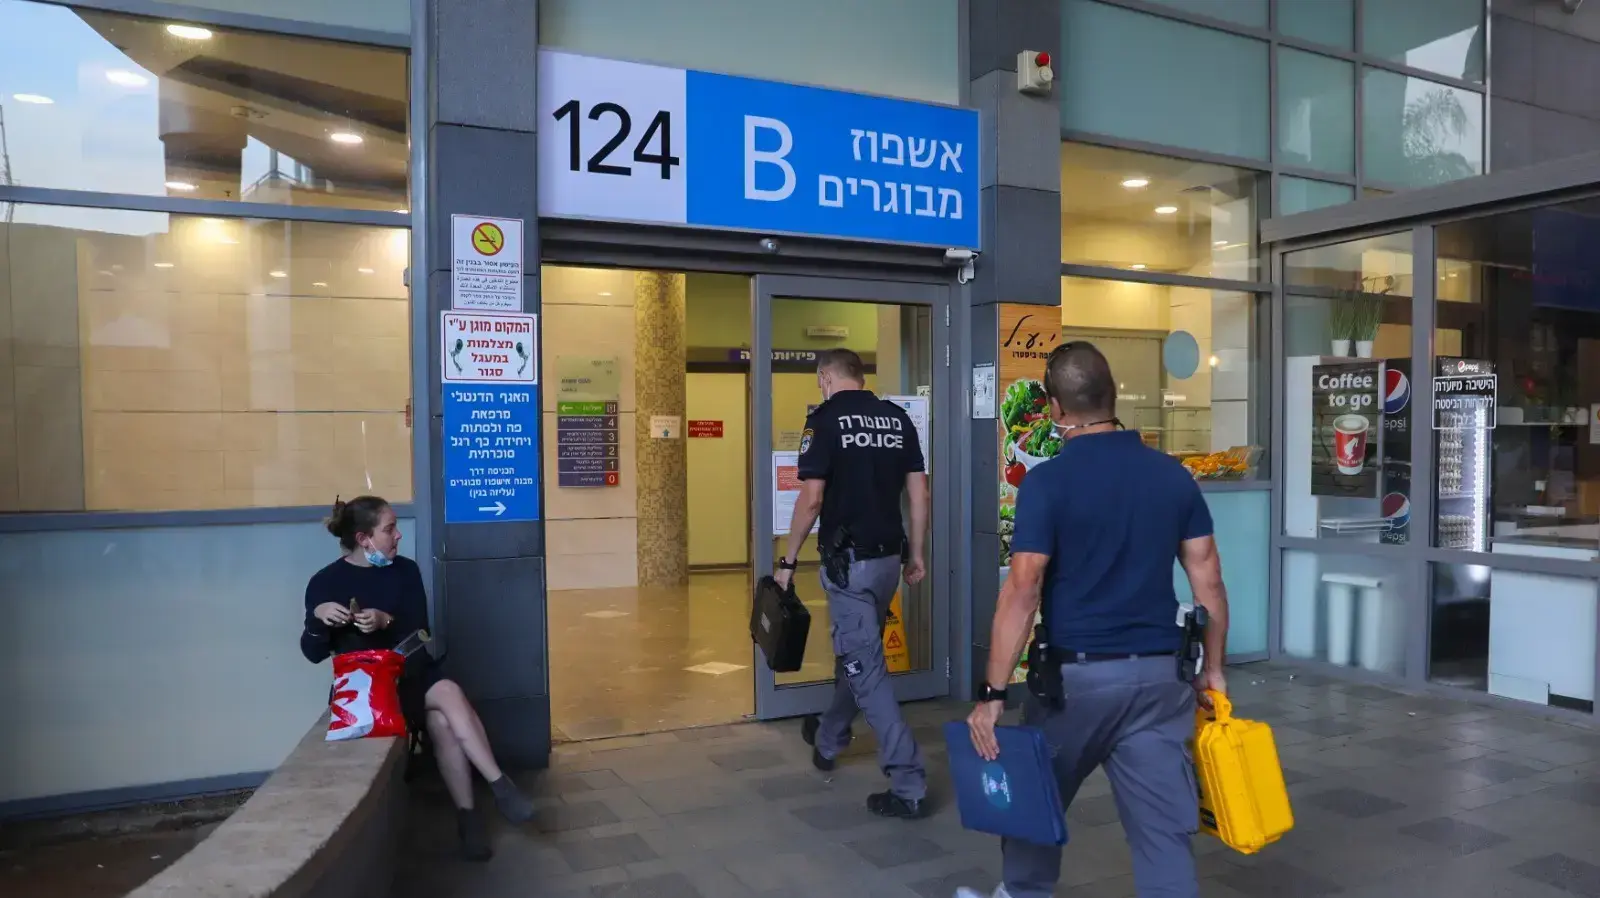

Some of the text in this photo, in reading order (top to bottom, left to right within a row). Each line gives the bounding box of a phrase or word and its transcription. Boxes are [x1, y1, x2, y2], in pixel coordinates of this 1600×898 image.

[553, 99, 680, 181] 124
[850, 128, 964, 173] אשפוז
[744, 115, 796, 201] B
[818, 174, 963, 219] מבוגרים
[470, 319, 492, 333] מוגן
[494, 320, 530, 335] המקום
[466, 338, 514, 349] מצלמות
[471, 352, 509, 363] במעגל
[1012, 351, 1037, 359] ביסטרו
[478, 368, 503, 376] סגור
[1319, 373, 1373, 389] Coffee
[1465, 379, 1494, 391] הישיבה
[451, 390, 530, 404] האגף הדנטלי
[1328, 392, 1372, 411] to go
[471, 410, 511, 419] מרפאת
[460, 422, 522, 433] פה ולסתות
[608, 418, 615, 427] 4
[838, 415, 902, 431] משטרה
[1384, 418, 1406, 429] epsi
[450, 435, 532, 448] ויחידת כף רגל
[608, 432, 615, 441] 3
[841, 432, 904, 449] POLICE
[468, 449, 515, 459] סוכרתית
[608, 446, 615, 456] 2
[609, 460, 615, 470] 1
[469, 467, 515, 477] הכניסה דרך
[450, 479, 481, 487] מבוגרים
[513, 477, 533, 485] מבנה
[608, 474, 616, 484] 0
